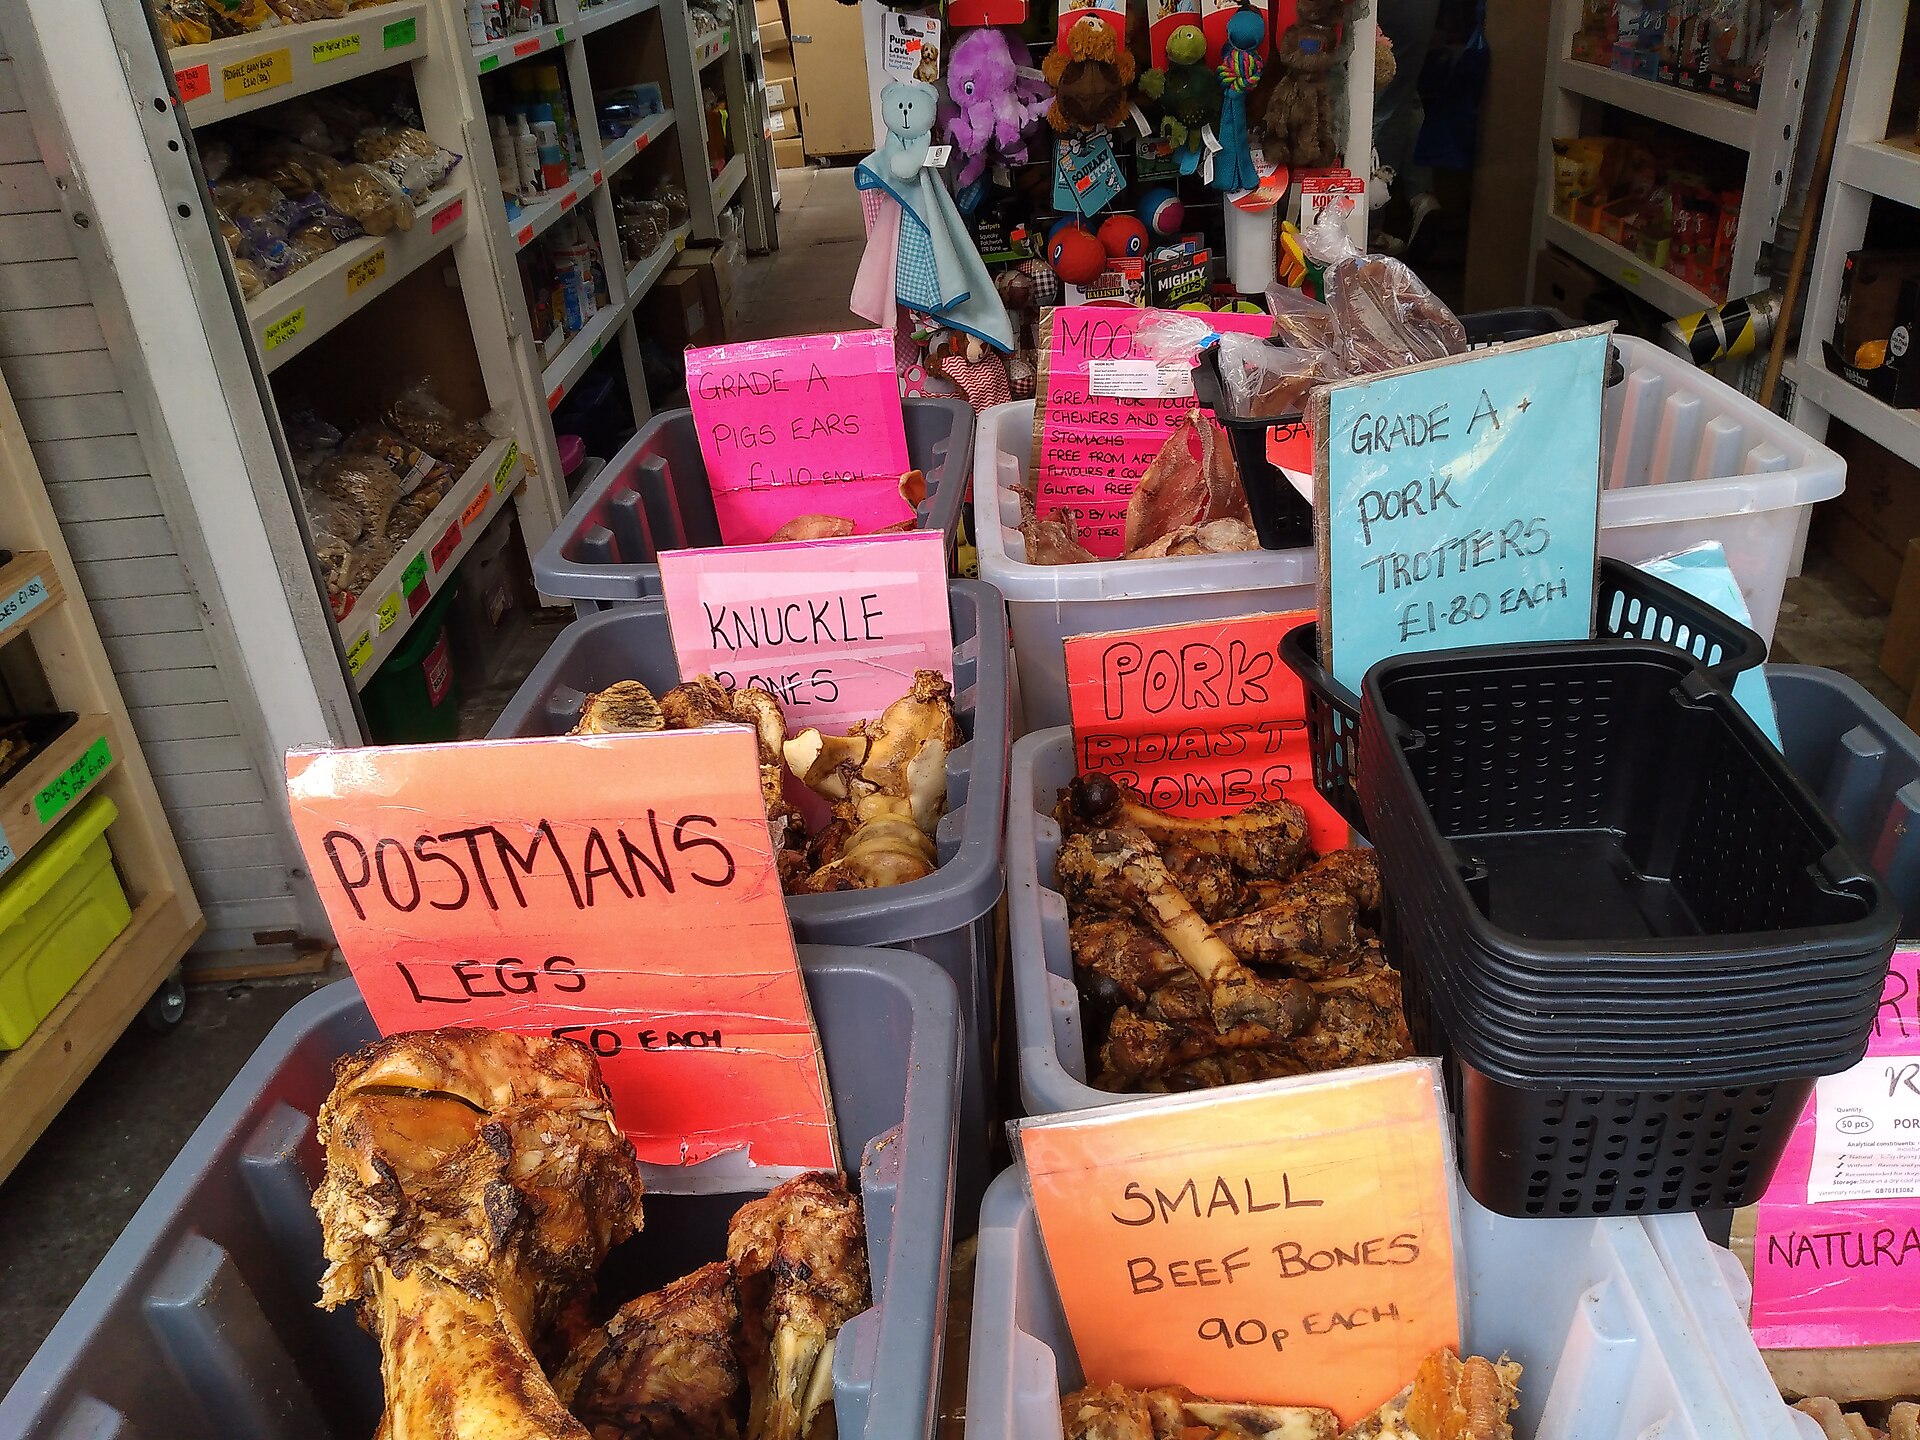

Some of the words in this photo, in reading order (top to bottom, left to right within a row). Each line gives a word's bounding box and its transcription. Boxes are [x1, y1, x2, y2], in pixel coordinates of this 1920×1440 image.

[889, 34, 921, 46] Pup
[1087, 289, 1123, 298] BALLISTIC
[1158, 266, 1205, 292] MIGHTY
[1173, 281, 1201, 297] PUPS
[699, 369, 789, 400] GRADE
[806, 362, 830, 392] A
[1052, 389, 1100, 406] GREAT
[712, 423, 776, 456] PIGS
[791, 413, 860, 440] EARS
[1052, 411, 1119, 425] CHEWERS
[1125, 413, 1158, 426] AND
[1351, 402, 1450, 455] GRADE
[1048, 450, 1081, 462] FREE
[1088, 450, 1126, 465] FROM
[1048, 465, 1104, 478] FLAVOURS
[1043, 482, 1095, 495] GLUTEN
[1104, 482, 1133, 495] FREE
[1088, 508, 1105, 521] BY
[1358, 474, 1462, 546] PORK
[1360, 517, 1551, 594] TROTTERS
[1500, 577, 1568, 614] EACH
[703, 594, 884, 651] KNUCKLE
[1103, 639, 1274, 720] PORK
[1085, 719, 1307, 770] ROAST
[41, 776, 69, 804] DUCK
[322, 808, 736, 921] POSTMANS
[396, 956, 587, 1003] LEGS
[638, 1029, 722, 1056] EACH
[1841, 1120, 1853, 1129] 50
[1854, 1121, 1870, 1130] pcs
[1111, 1172, 1324, 1226] SMALL
[1126, 1246, 1251, 1295] BEEF
[1271, 1233, 1420, 1279] BONES
[1197, 1317, 1290, 1352] 90p
